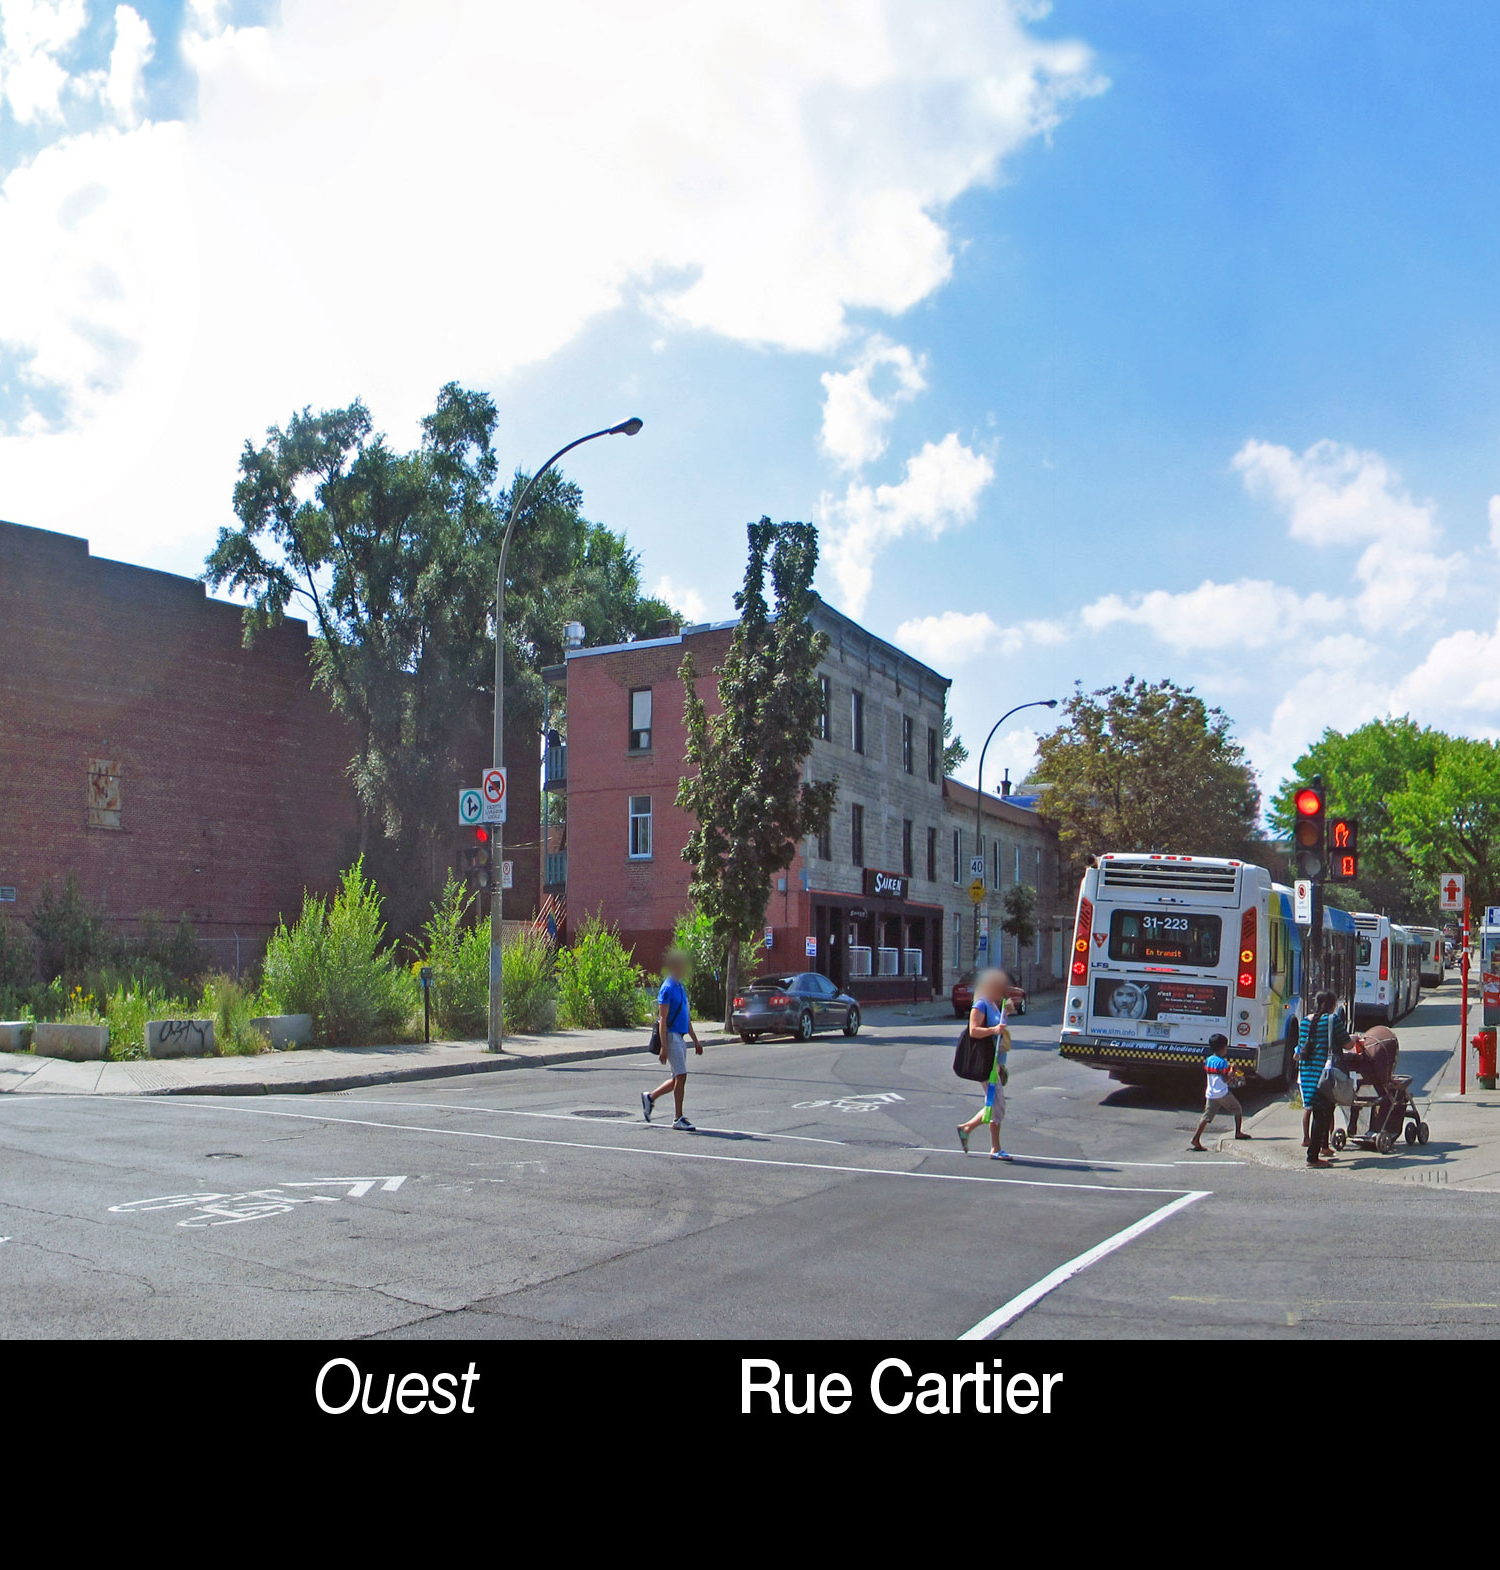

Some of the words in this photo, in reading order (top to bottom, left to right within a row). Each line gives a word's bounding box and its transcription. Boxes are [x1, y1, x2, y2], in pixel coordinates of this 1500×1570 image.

[971, 861, 983, 873] 40
[1142, 916, 1189, 930] 31-223
[1146, 948, 1155, 956] En
[1156, 949, 1182, 958] transit
[1090, 1027, 1136, 1037] www.stm.info
[1168, 1044, 1205, 1053] biodiesel
